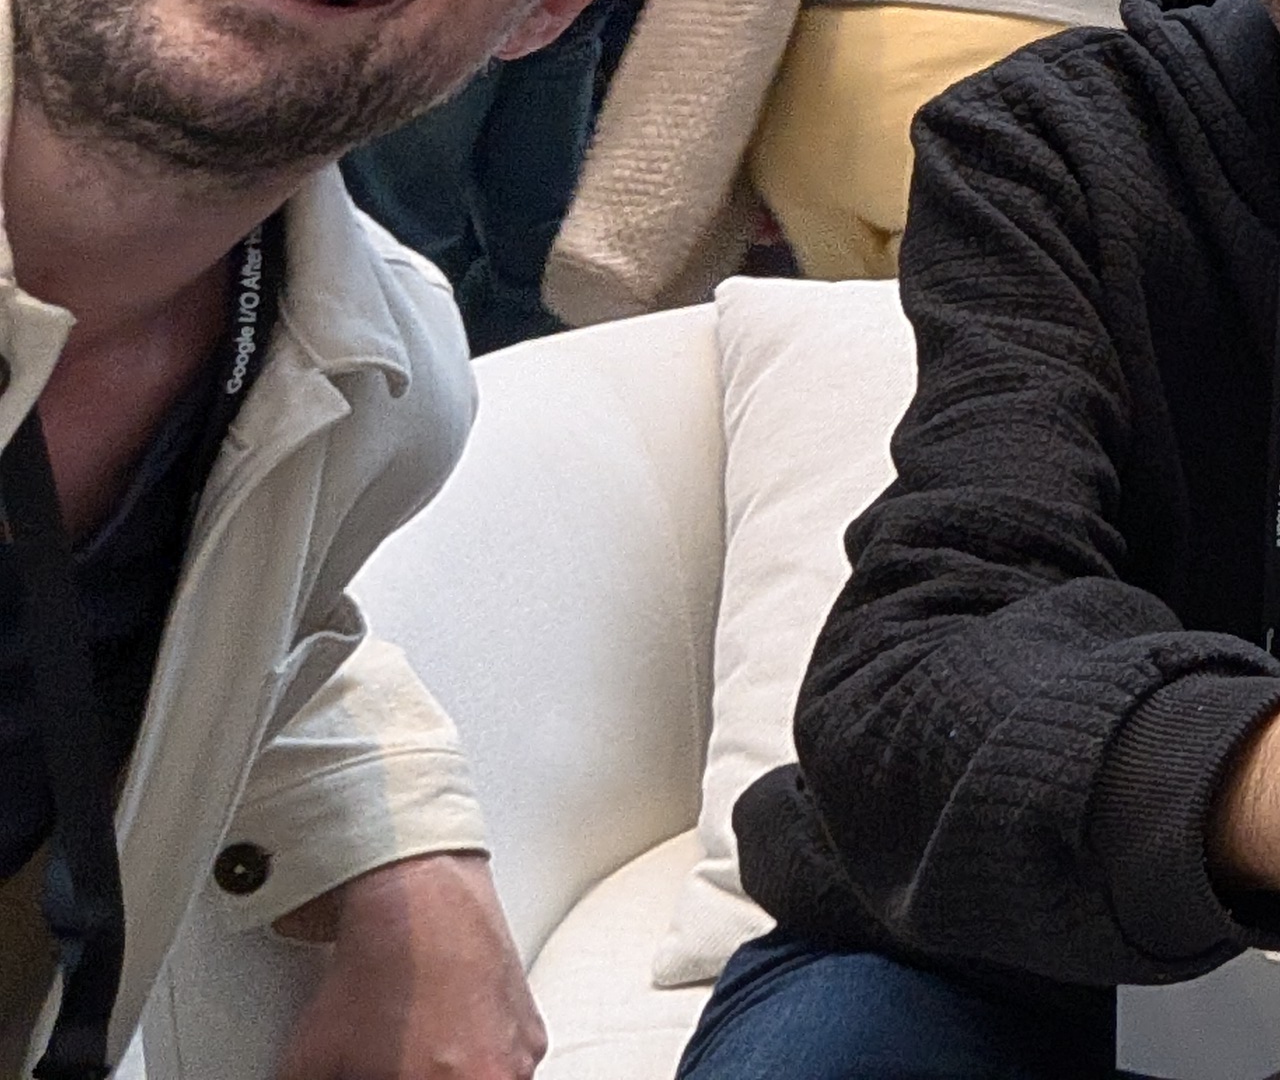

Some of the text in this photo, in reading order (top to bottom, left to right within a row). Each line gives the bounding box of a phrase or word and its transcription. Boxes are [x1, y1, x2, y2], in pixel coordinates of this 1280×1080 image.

[240, 247, 262, 291] After
[238, 291, 260, 323] I/O
[226, 326, 255, 394] Google
